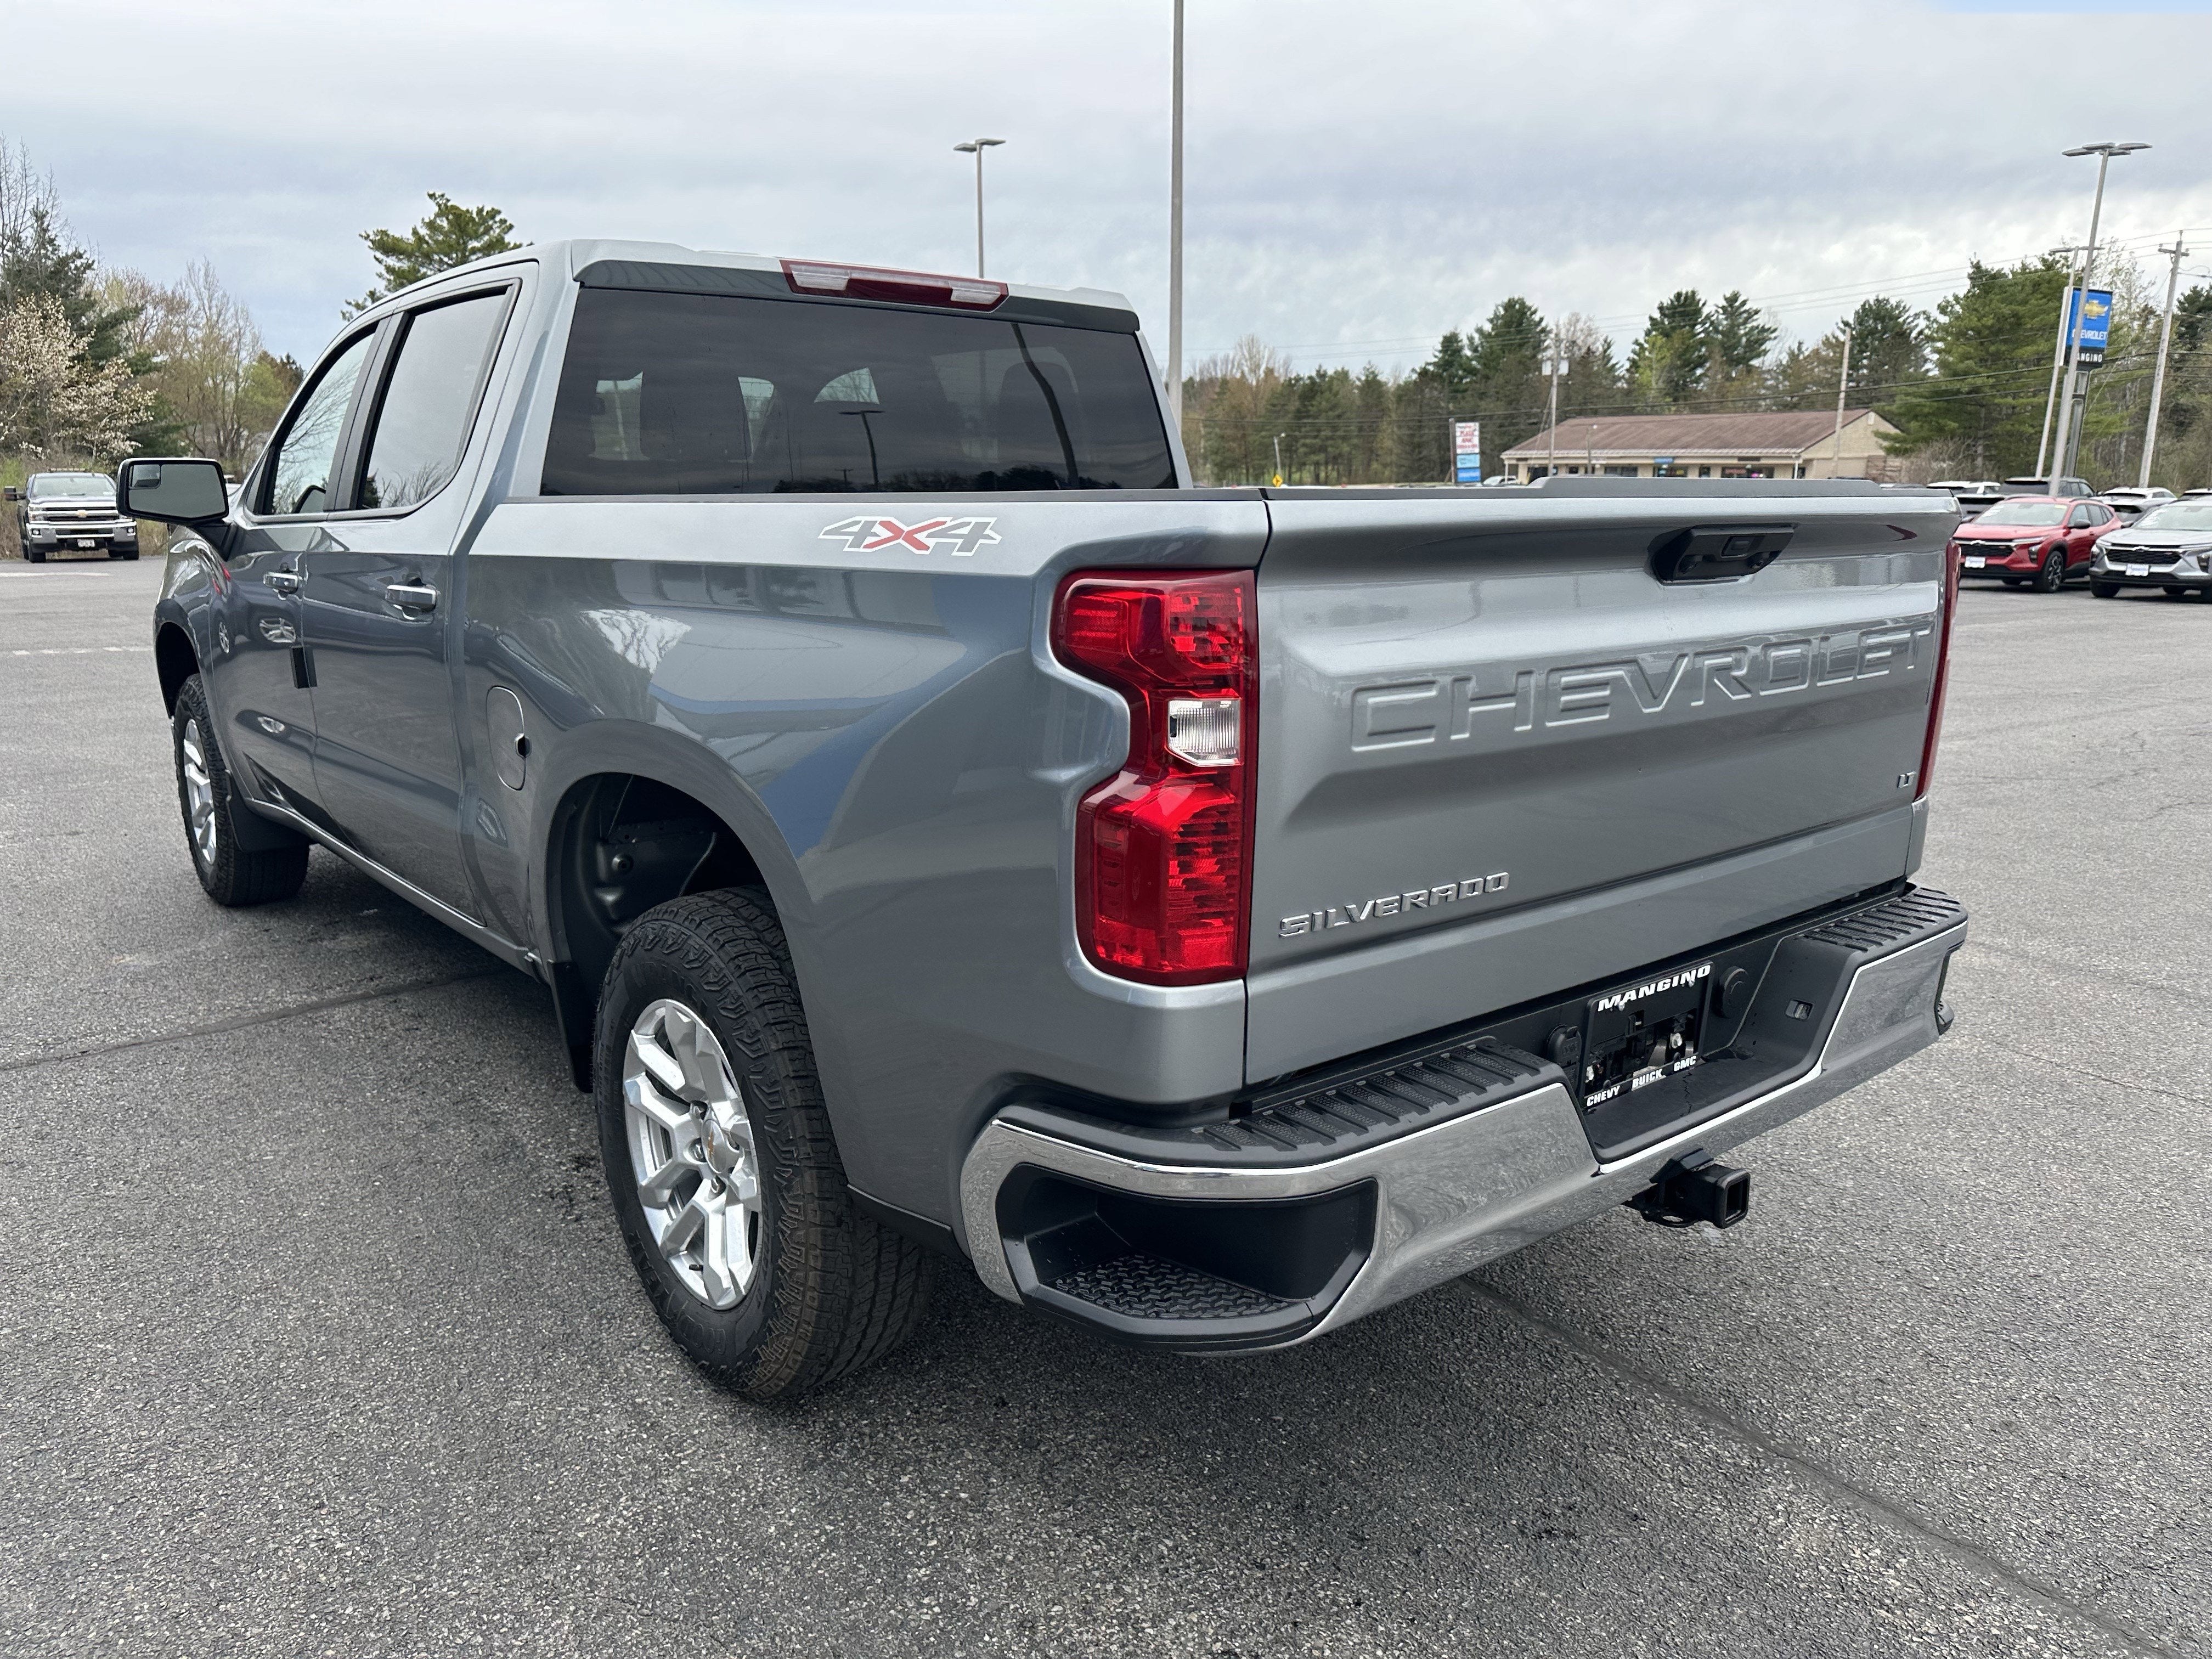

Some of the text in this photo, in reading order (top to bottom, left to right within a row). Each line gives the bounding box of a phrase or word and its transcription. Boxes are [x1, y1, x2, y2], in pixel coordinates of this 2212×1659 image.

[2072, 329, 2107, 340] EVROLET
[2076, 353, 2103, 362] ANGINO
[1351, 628, 1933, 752] CHEVROLET
[1897, 771, 1916, 788] LT
[1279, 872, 1509, 937] SILVERADO
[1597, 964, 1711, 1012] MANGINO
[1587, 1056, 1696, 1107] CHEVY BUICK GMC
[629, 1229, 726, 1355] GOODYEAR
